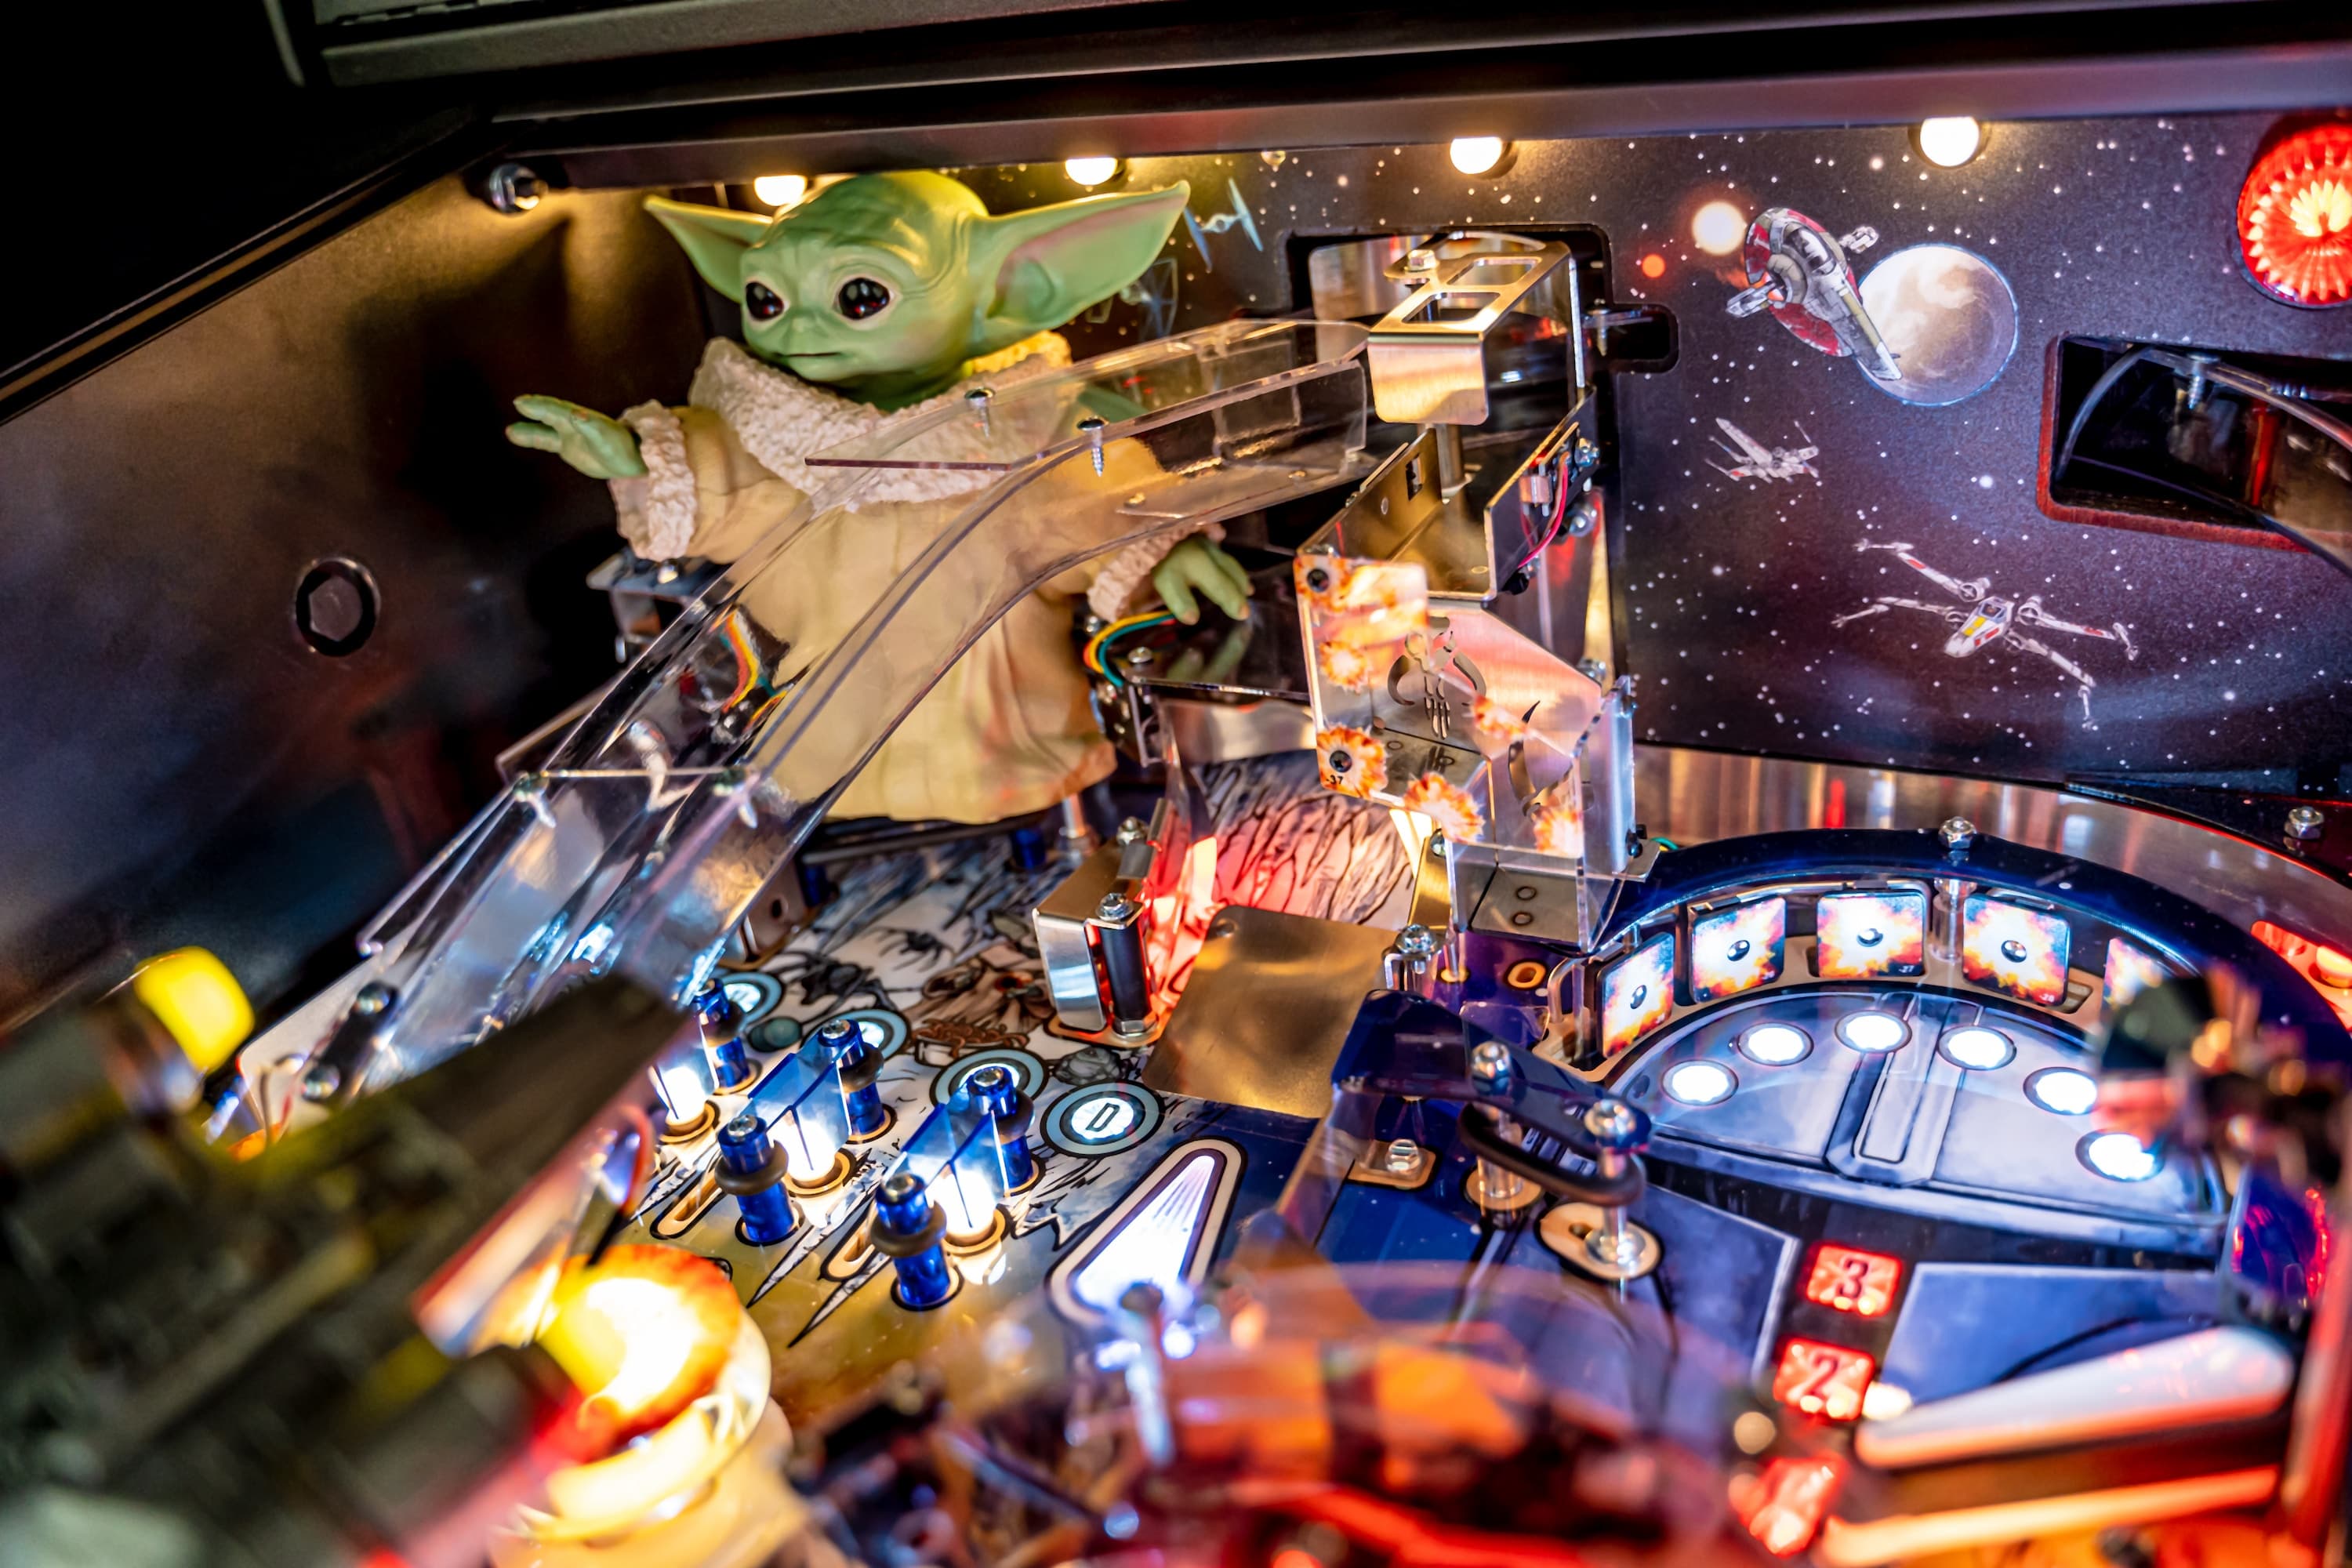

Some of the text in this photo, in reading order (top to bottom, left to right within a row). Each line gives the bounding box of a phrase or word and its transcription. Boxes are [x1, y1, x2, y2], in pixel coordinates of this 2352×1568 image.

[1085, 1102, 1120, 1132] D
[1835, 1258, 1868, 1300] 3
[1804, 1356, 1838, 1400] 2
